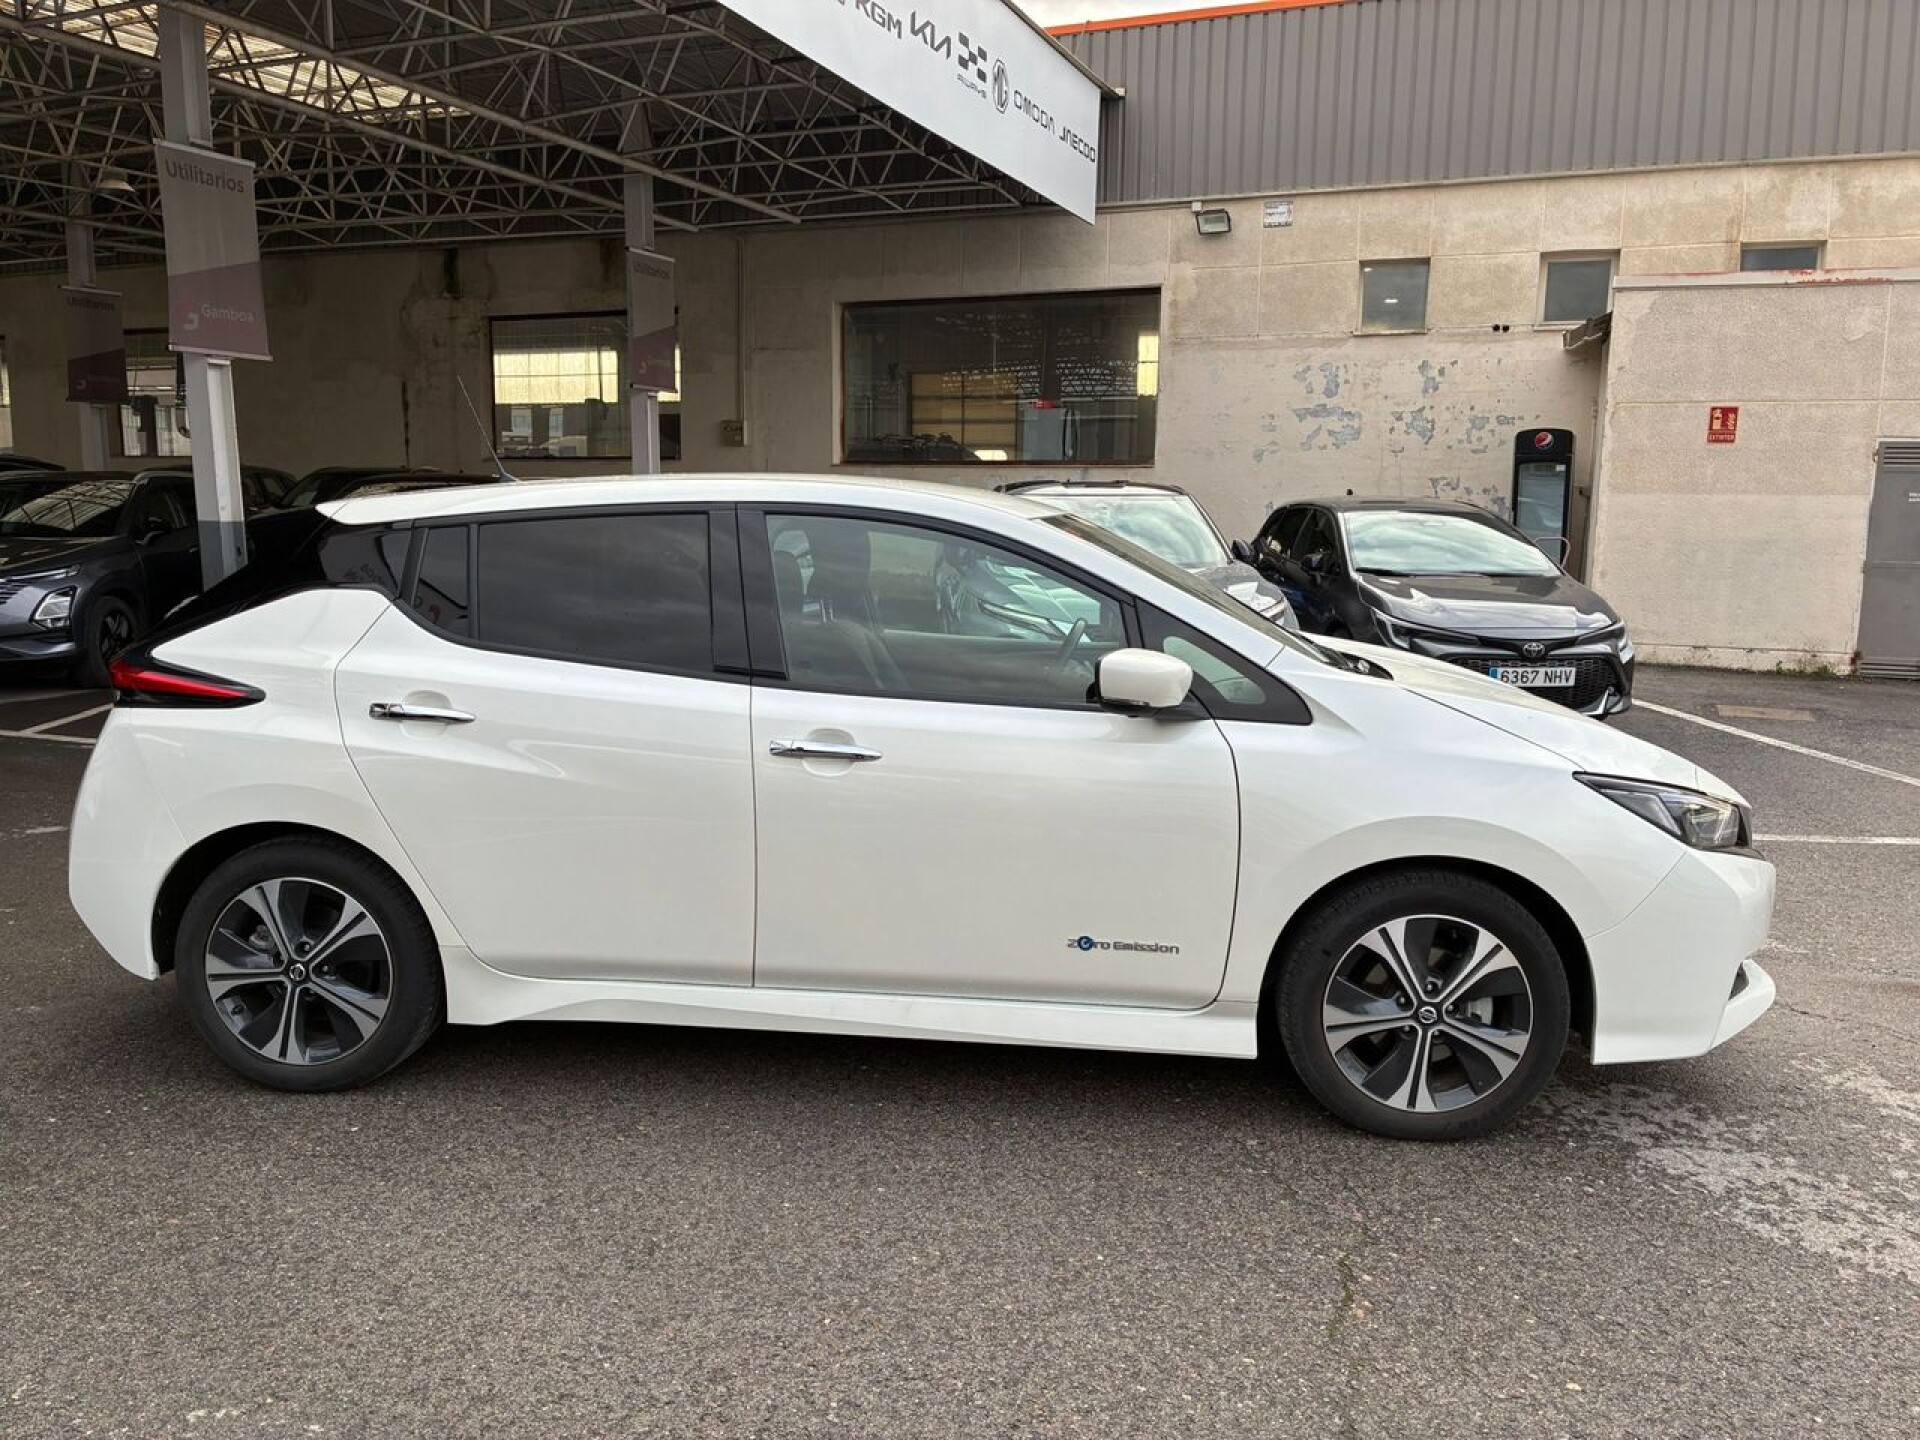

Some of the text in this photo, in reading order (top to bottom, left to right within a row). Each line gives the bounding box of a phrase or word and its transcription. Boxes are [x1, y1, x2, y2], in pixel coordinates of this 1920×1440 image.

[911, 10, 951, 60] KIA
[165, 156, 244, 192] Utilitarios
[1501, 669, 1573, 684] 6367 NHV
[1113, 940, 1180, 955] Emission
